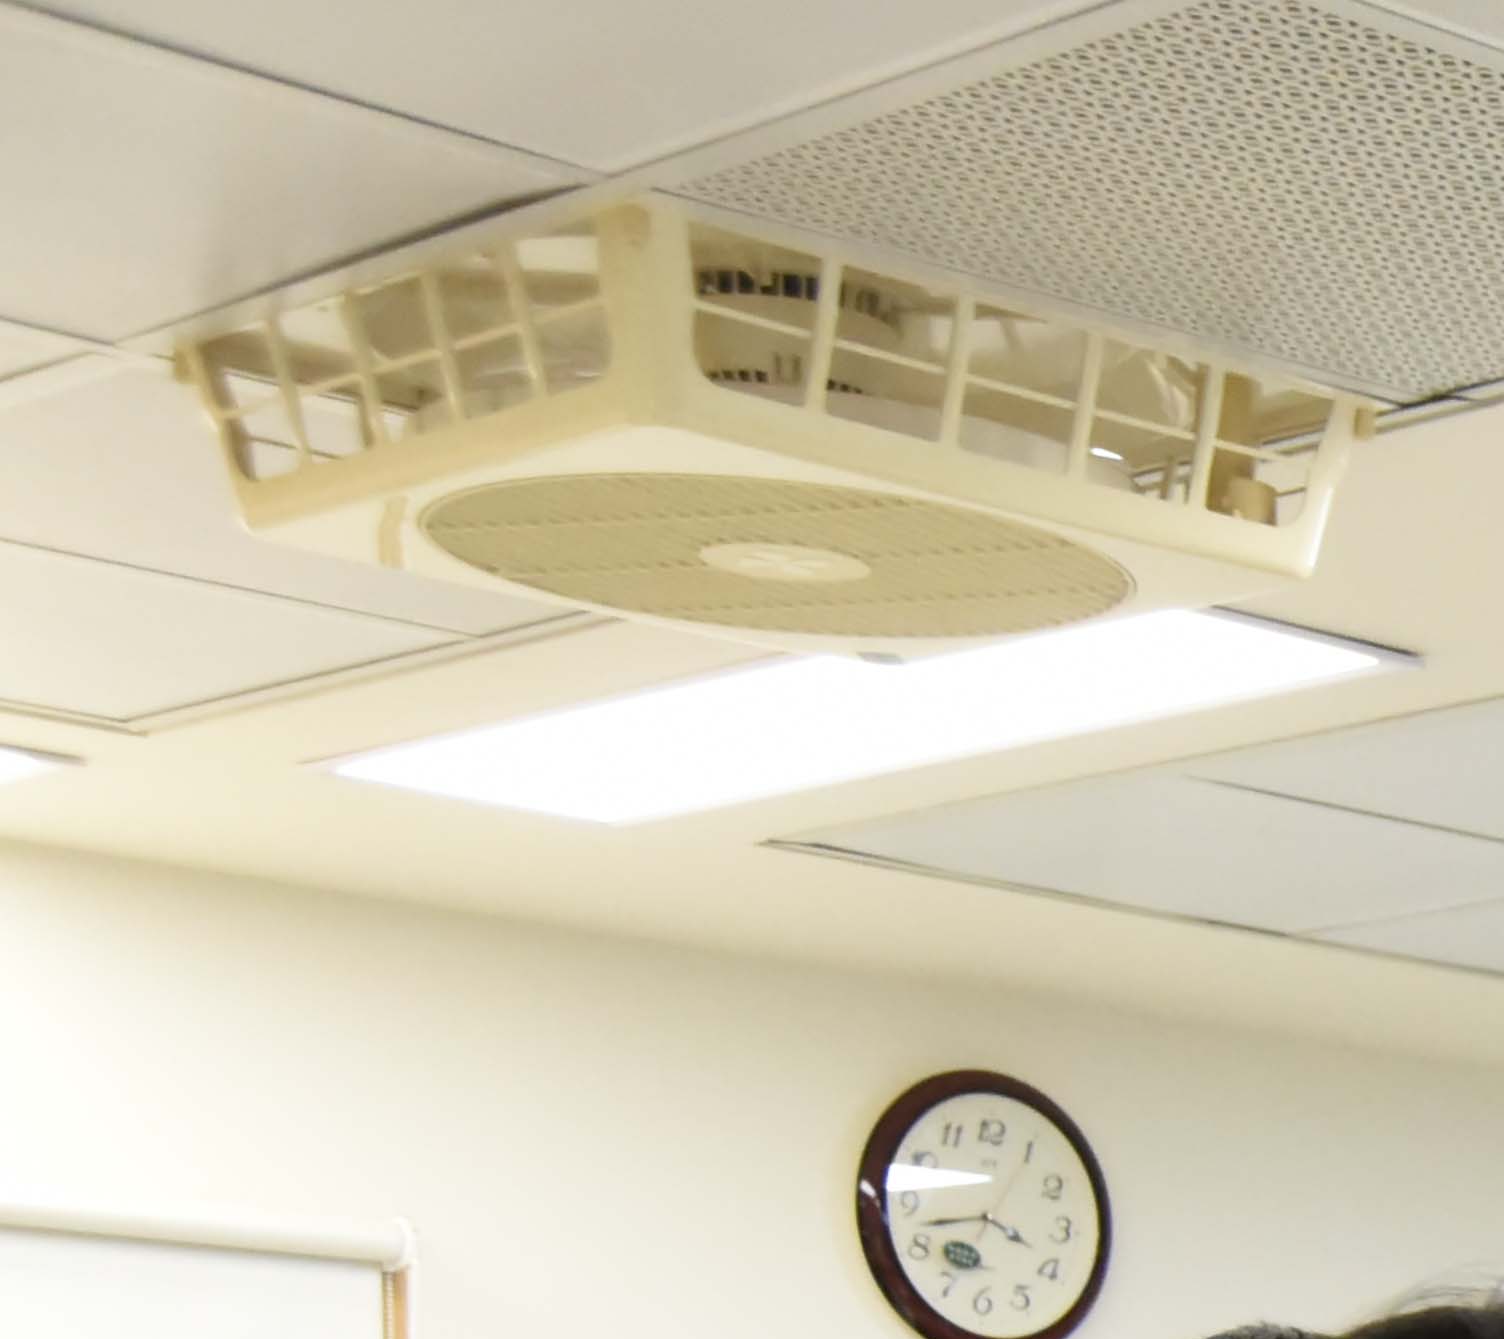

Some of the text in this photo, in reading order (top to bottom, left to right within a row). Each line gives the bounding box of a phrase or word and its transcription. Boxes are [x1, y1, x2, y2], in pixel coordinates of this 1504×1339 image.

[941, 1122, 963, 1148] 11
[978, 1119, 1006, 1146] 12
[1023, 1140, 1034, 1164] 1
[1041, 1174, 1064, 1201] 2
[900, 1190, 920, 1216] 9
[1049, 1216, 1072, 1244] 3
[907, 1233, 931, 1260] 8
[1037, 1258, 1060, 1280] 4
[940, 1269, 957, 1298] 7
[972, 1286, 993, 1316] 6
[1010, 1285, 1031, 1311] 5
